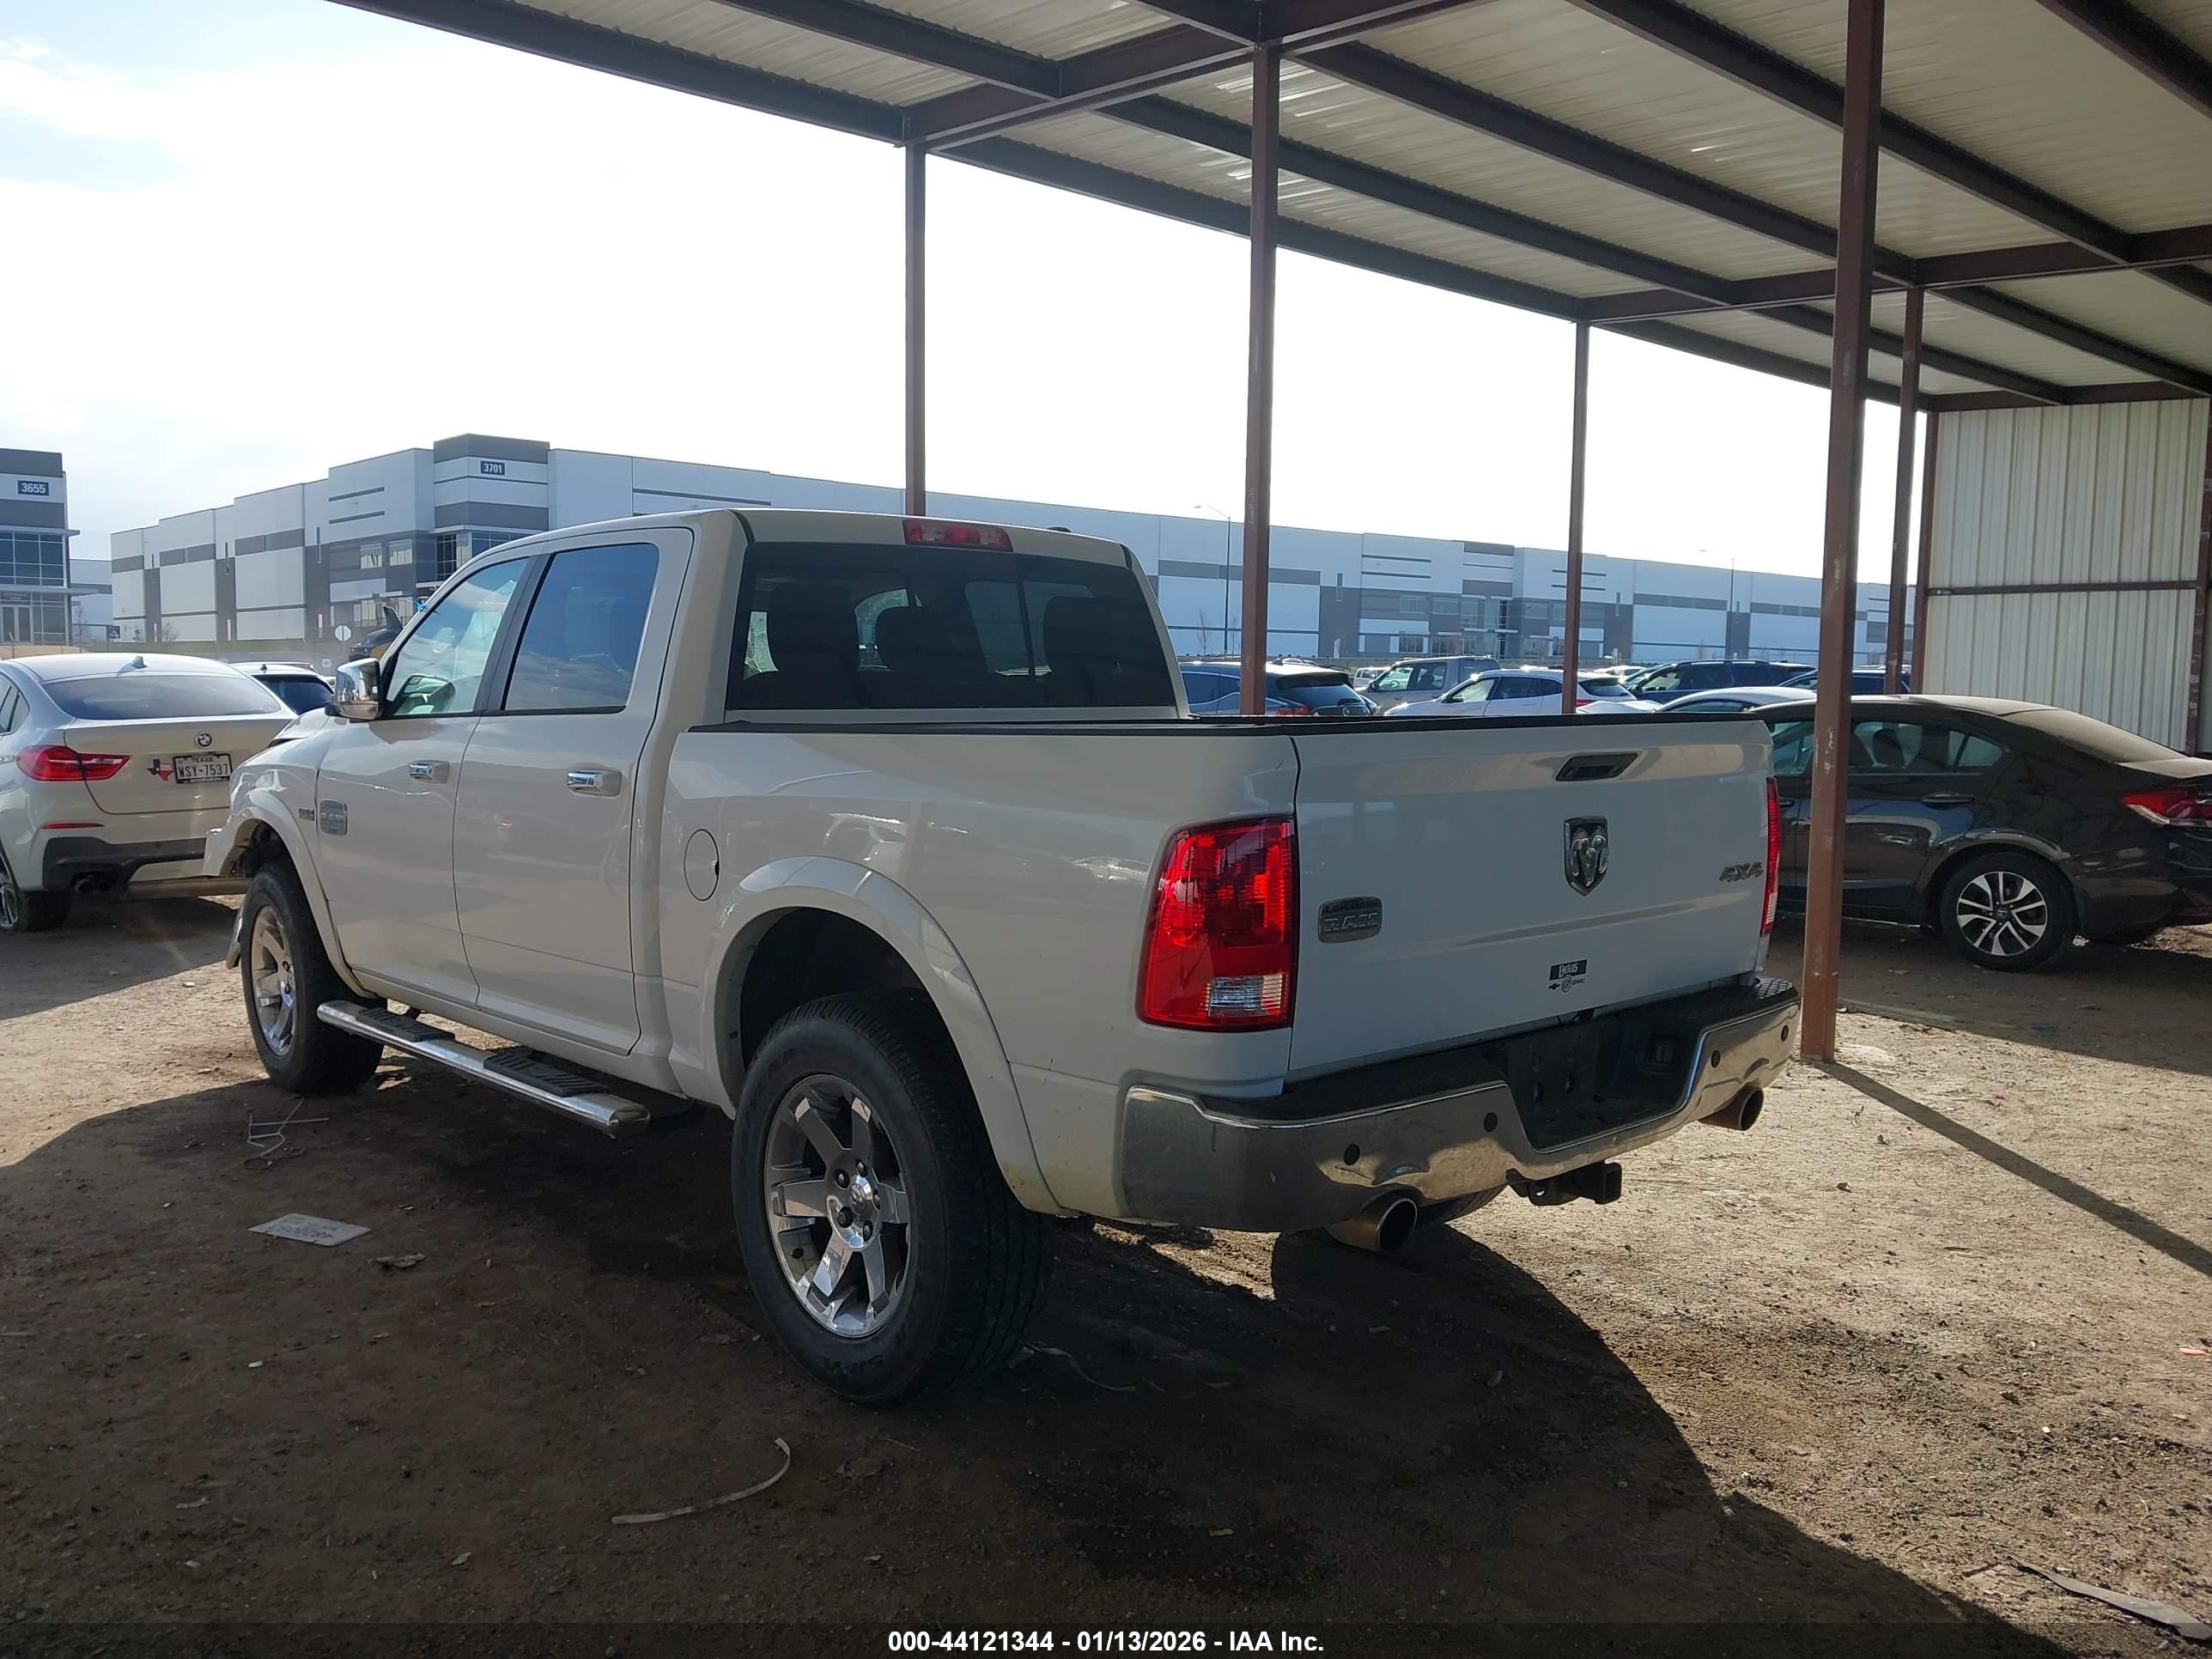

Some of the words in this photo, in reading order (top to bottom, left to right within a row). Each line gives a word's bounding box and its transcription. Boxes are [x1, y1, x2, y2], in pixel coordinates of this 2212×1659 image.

[483, 463, 502, 474] 3701
[21, 483, 46, 494] 3655
[1324, 912, 1378, 932] RAM
